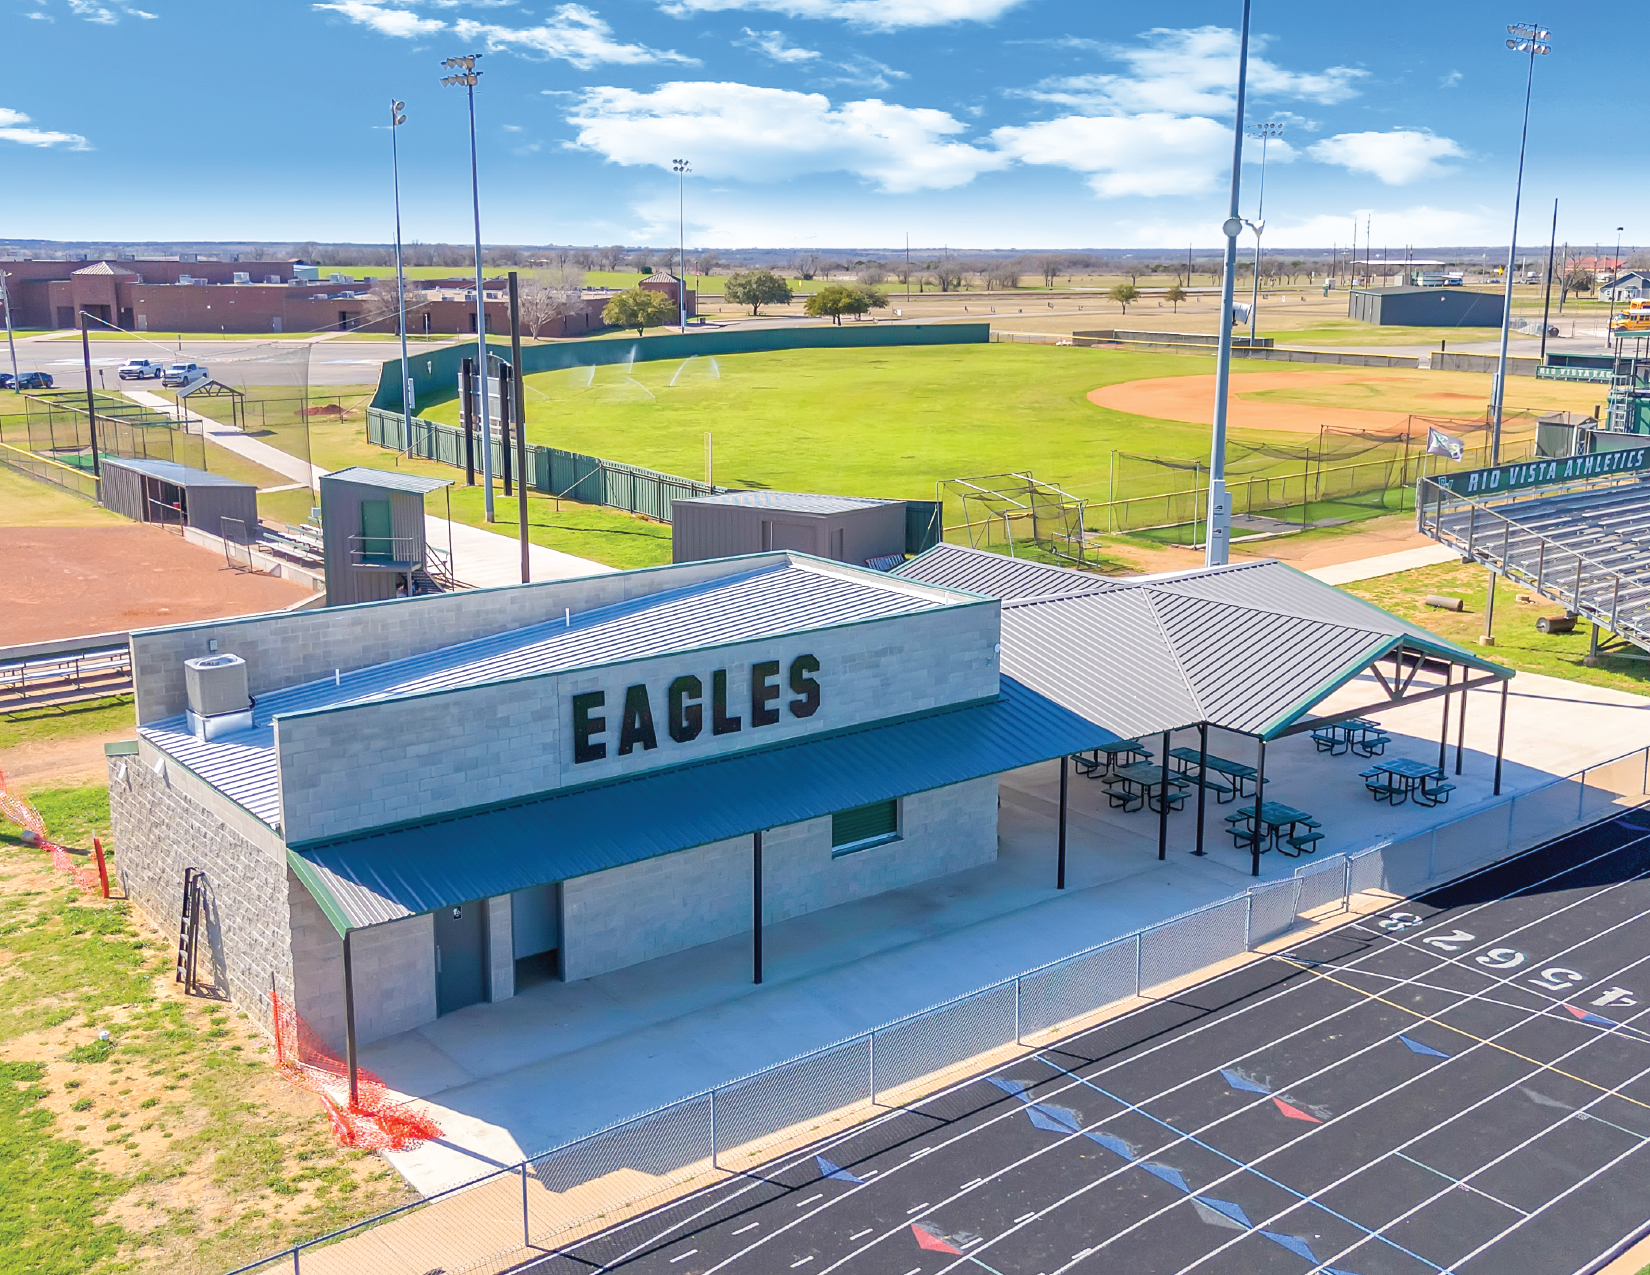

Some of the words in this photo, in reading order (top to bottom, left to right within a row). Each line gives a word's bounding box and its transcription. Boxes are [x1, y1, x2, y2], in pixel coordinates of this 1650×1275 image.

[1539, 367, 1556, 375] RIO
[1560, 368, 1590, 377] VISTA
[1592, 370, 1613, 380] EAG
[1468, 470, 1500, 492] RIO
[1509, 462, 1557, 486] VISTA
[1563, 449, 1645, 477] ATHLETICS
[573, 654, 820, 764] EAGLES
[1528, 967, 1583, 990] 5
[1589, 986, 1638, 1006] 4
